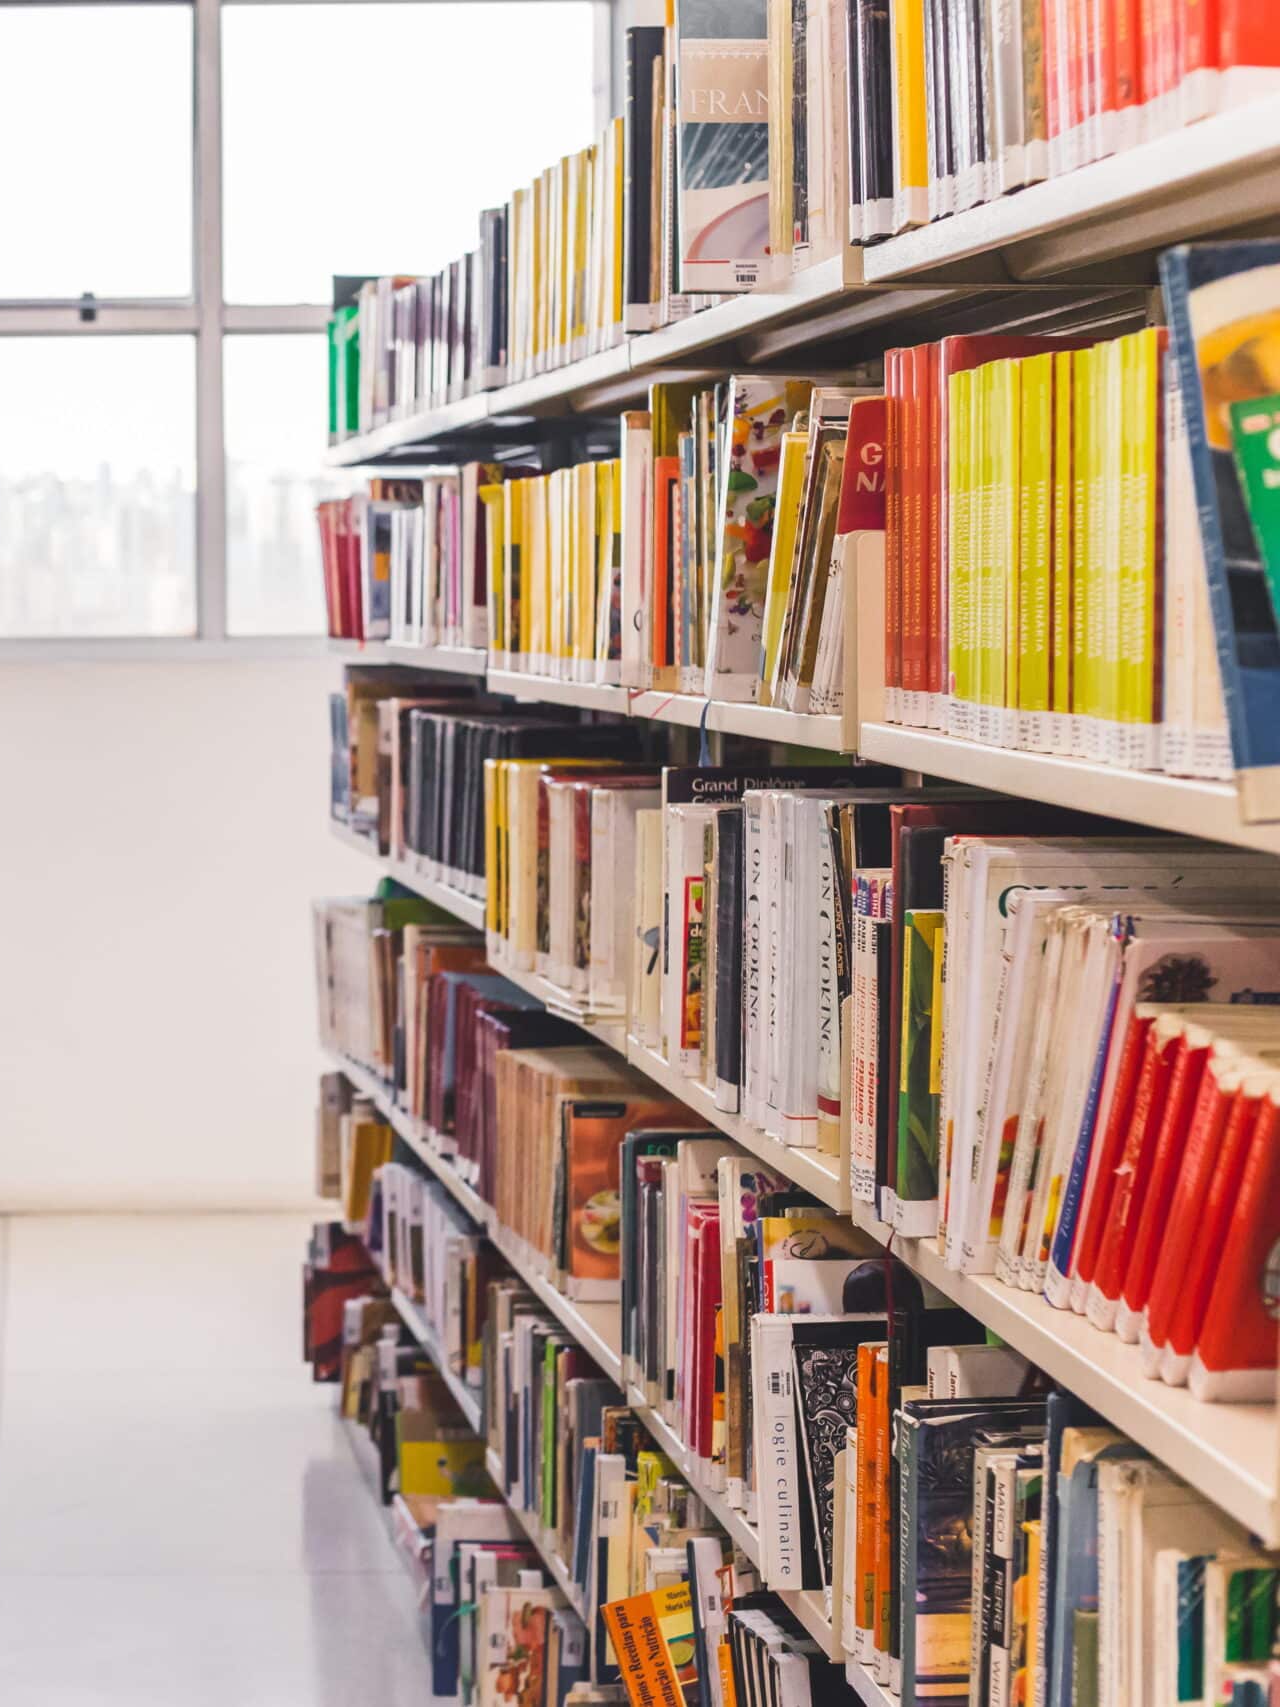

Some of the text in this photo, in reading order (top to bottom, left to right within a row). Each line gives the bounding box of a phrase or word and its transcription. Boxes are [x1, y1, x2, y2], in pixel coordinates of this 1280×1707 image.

[692, 777, 738, 792] Grand
[821, 861, 831, 901] ON
[856, 1058, 865, 1124] cientista
[867, 1062, 875, 1127] cientista
[777, 1478, 794, 1576] culinaire
[997, 1482, 1006, 1543] MARCO
[615, 1605, 634, 1630] para
[993, 1569, 1003, 1633] PIERRE
[623, 1629, 642, 1673] Receitas
[639, 1616, 659, 1661] Nutrição
